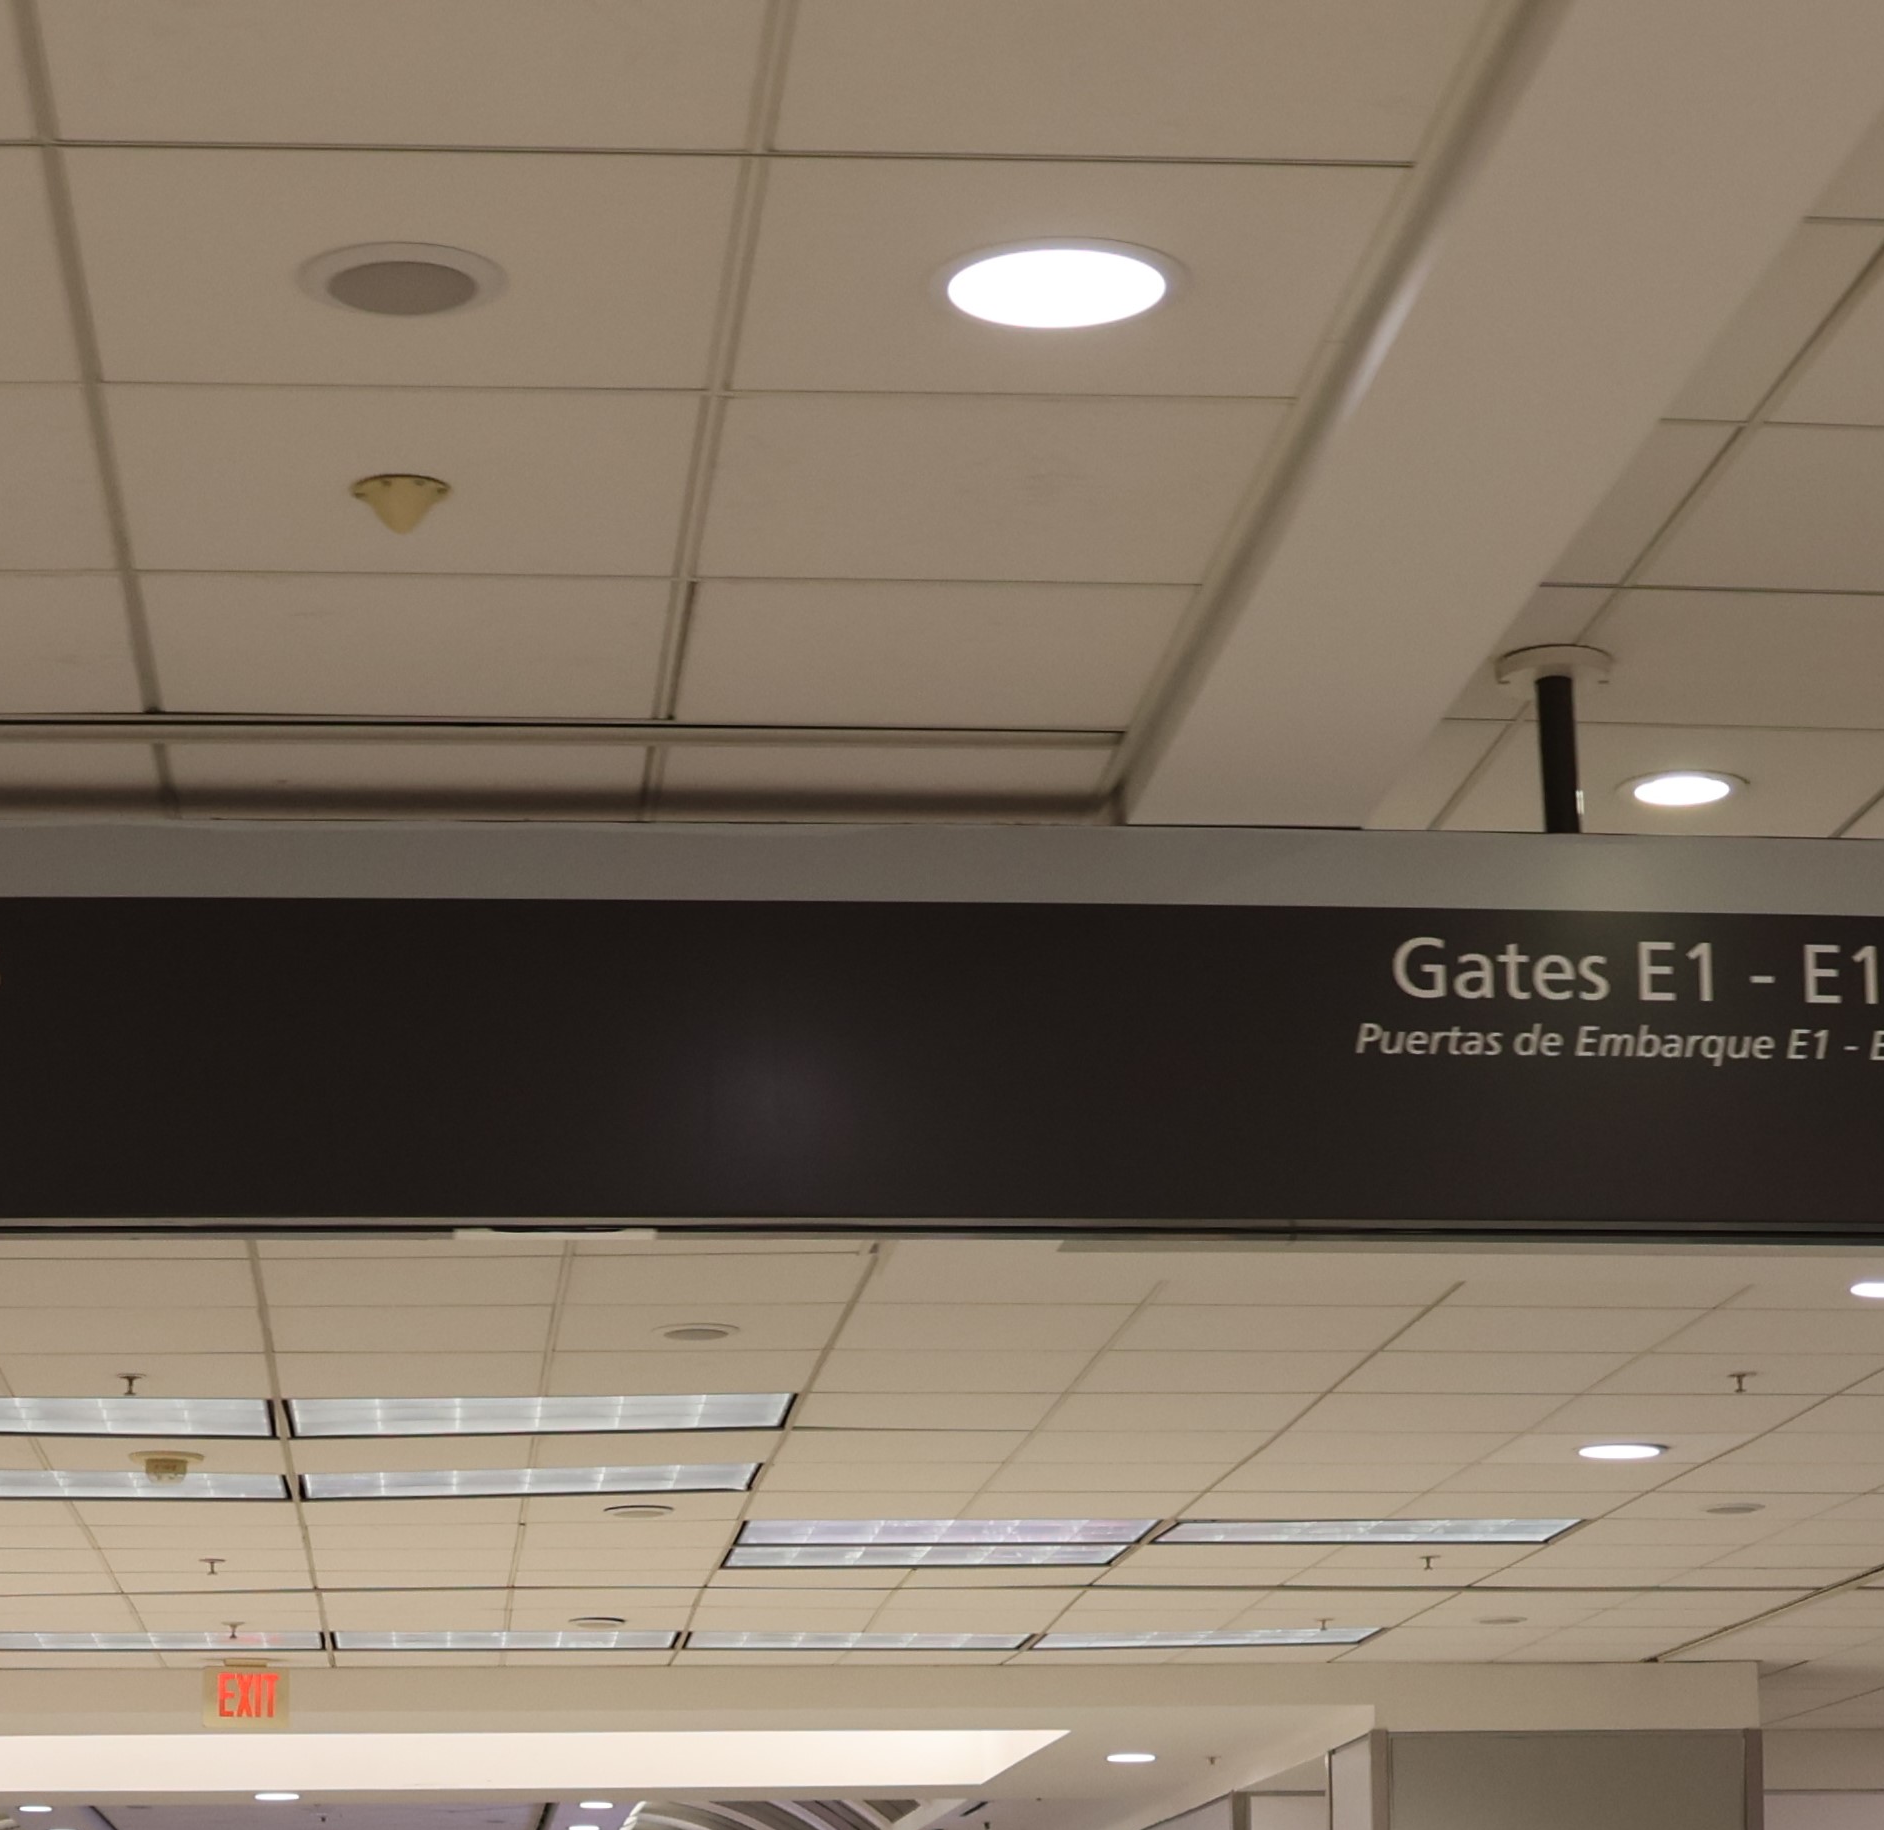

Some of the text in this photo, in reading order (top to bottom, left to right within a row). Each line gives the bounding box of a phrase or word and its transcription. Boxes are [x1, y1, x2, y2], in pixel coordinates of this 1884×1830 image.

[1391, 936, 1611, 1002] Gates
[1637, 941, 1714, 1002] E1
[1355, 1022, 1503, 1056] Puertas
[1512, 1023, 1564, 1057] de
[1574, 1025, 1776, 1066] Embarque
[1786, 1028, 1829, 1061] E1
[217, 1672, 280, 1718] EXIT
